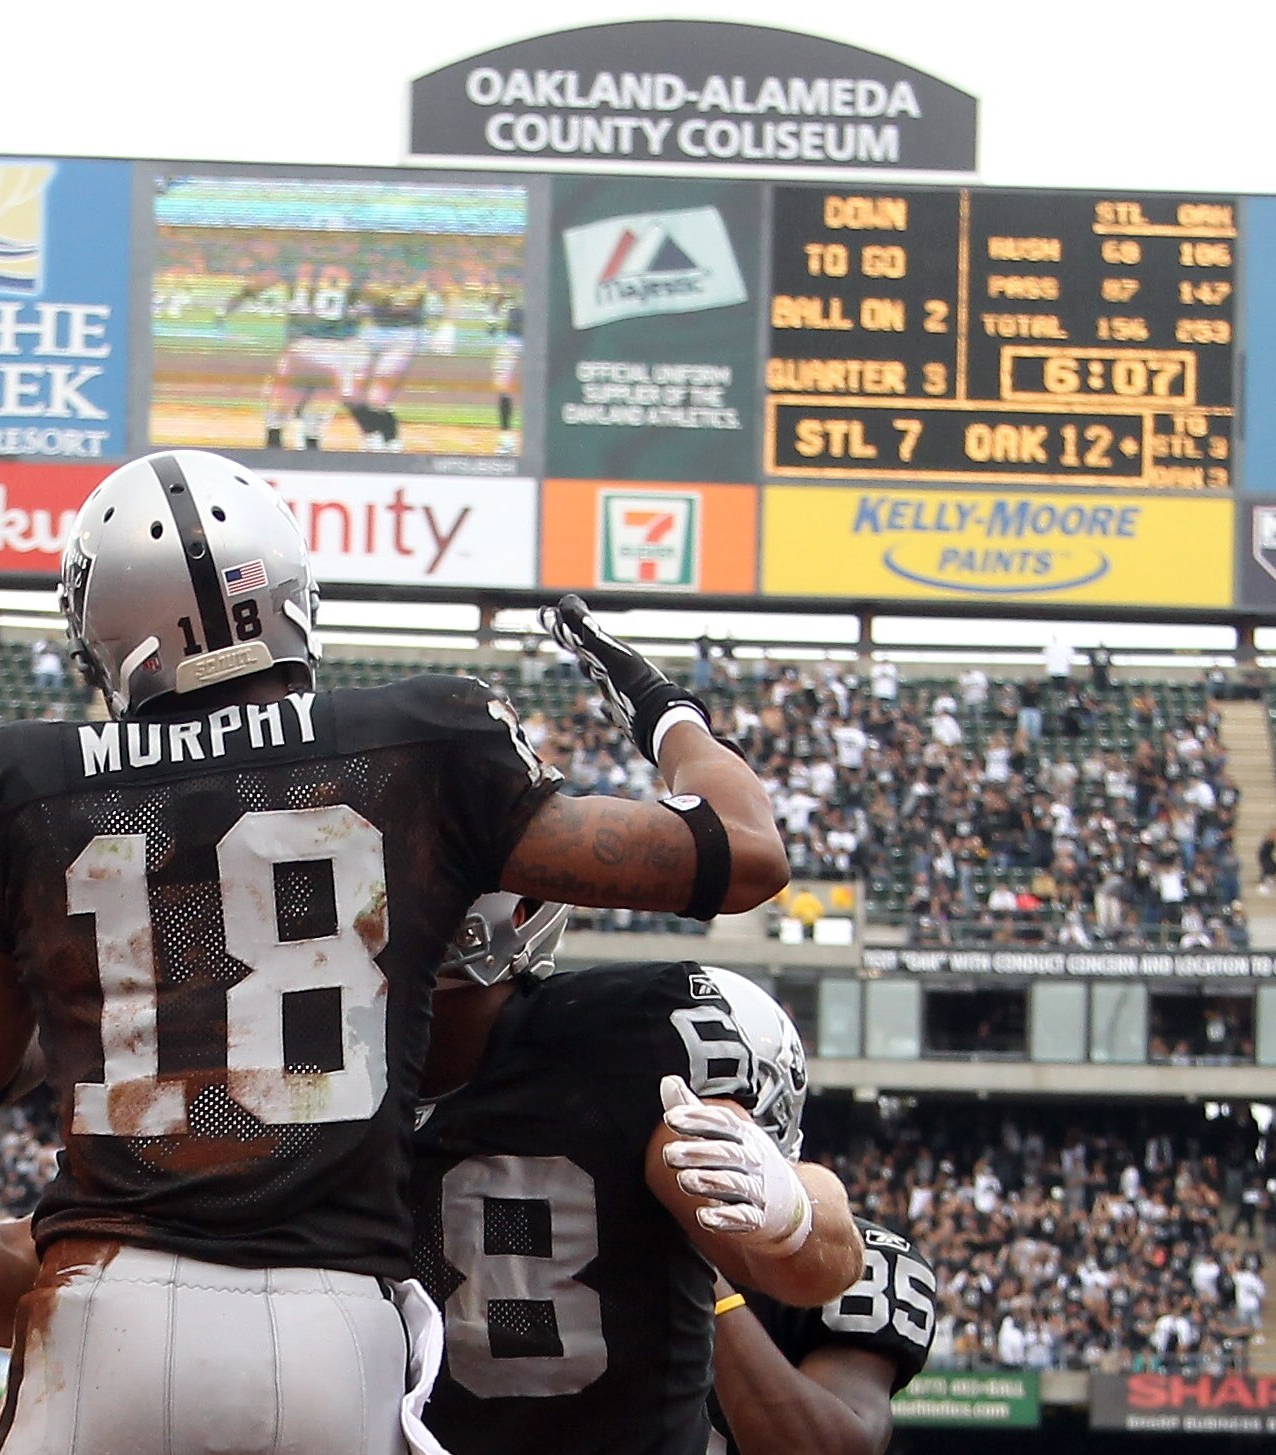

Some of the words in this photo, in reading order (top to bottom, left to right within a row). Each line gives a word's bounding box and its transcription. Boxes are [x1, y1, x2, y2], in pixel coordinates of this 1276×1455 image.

[466, 70, 922, 118] OAKLAND-ALAMEDA
[485, 113, 672, 155] COUNTY
[677, 119, 901, 163] COLISEUM
[823, 196, 908, 232] DOWN
[1094, 200, 1150, 225] STL
[804, 242, 848, 278] TO
[861, 245, 907, 279] GO
[1179, 280, 1232, 305] 147
[771, 296, 854, 331] BALL
[860, 299, 906, 332] ON
[924, 300, 949, 333] 2
[980, 312, 1069, 339] TOTAL
[766, 357, 907, 395] QUARTER
[924, 362, 948, 395] 3
[1042, 356, 1184, 398] 6:07
[795, 418, 878, 459] STL
[893, 418, 923, 462] 7
[964, 422, 1049, 464] OAK
[1060, 424, 1114, 468] 12
[852, 493, 1143, 540] KELLY-MOORE
[938, 547, 1053, 576] PAINTS
[77, 692, 316, 777] MURPHY
[66, 804, 389, 1136] 18
[821, 1248, 937, 1348] 85
